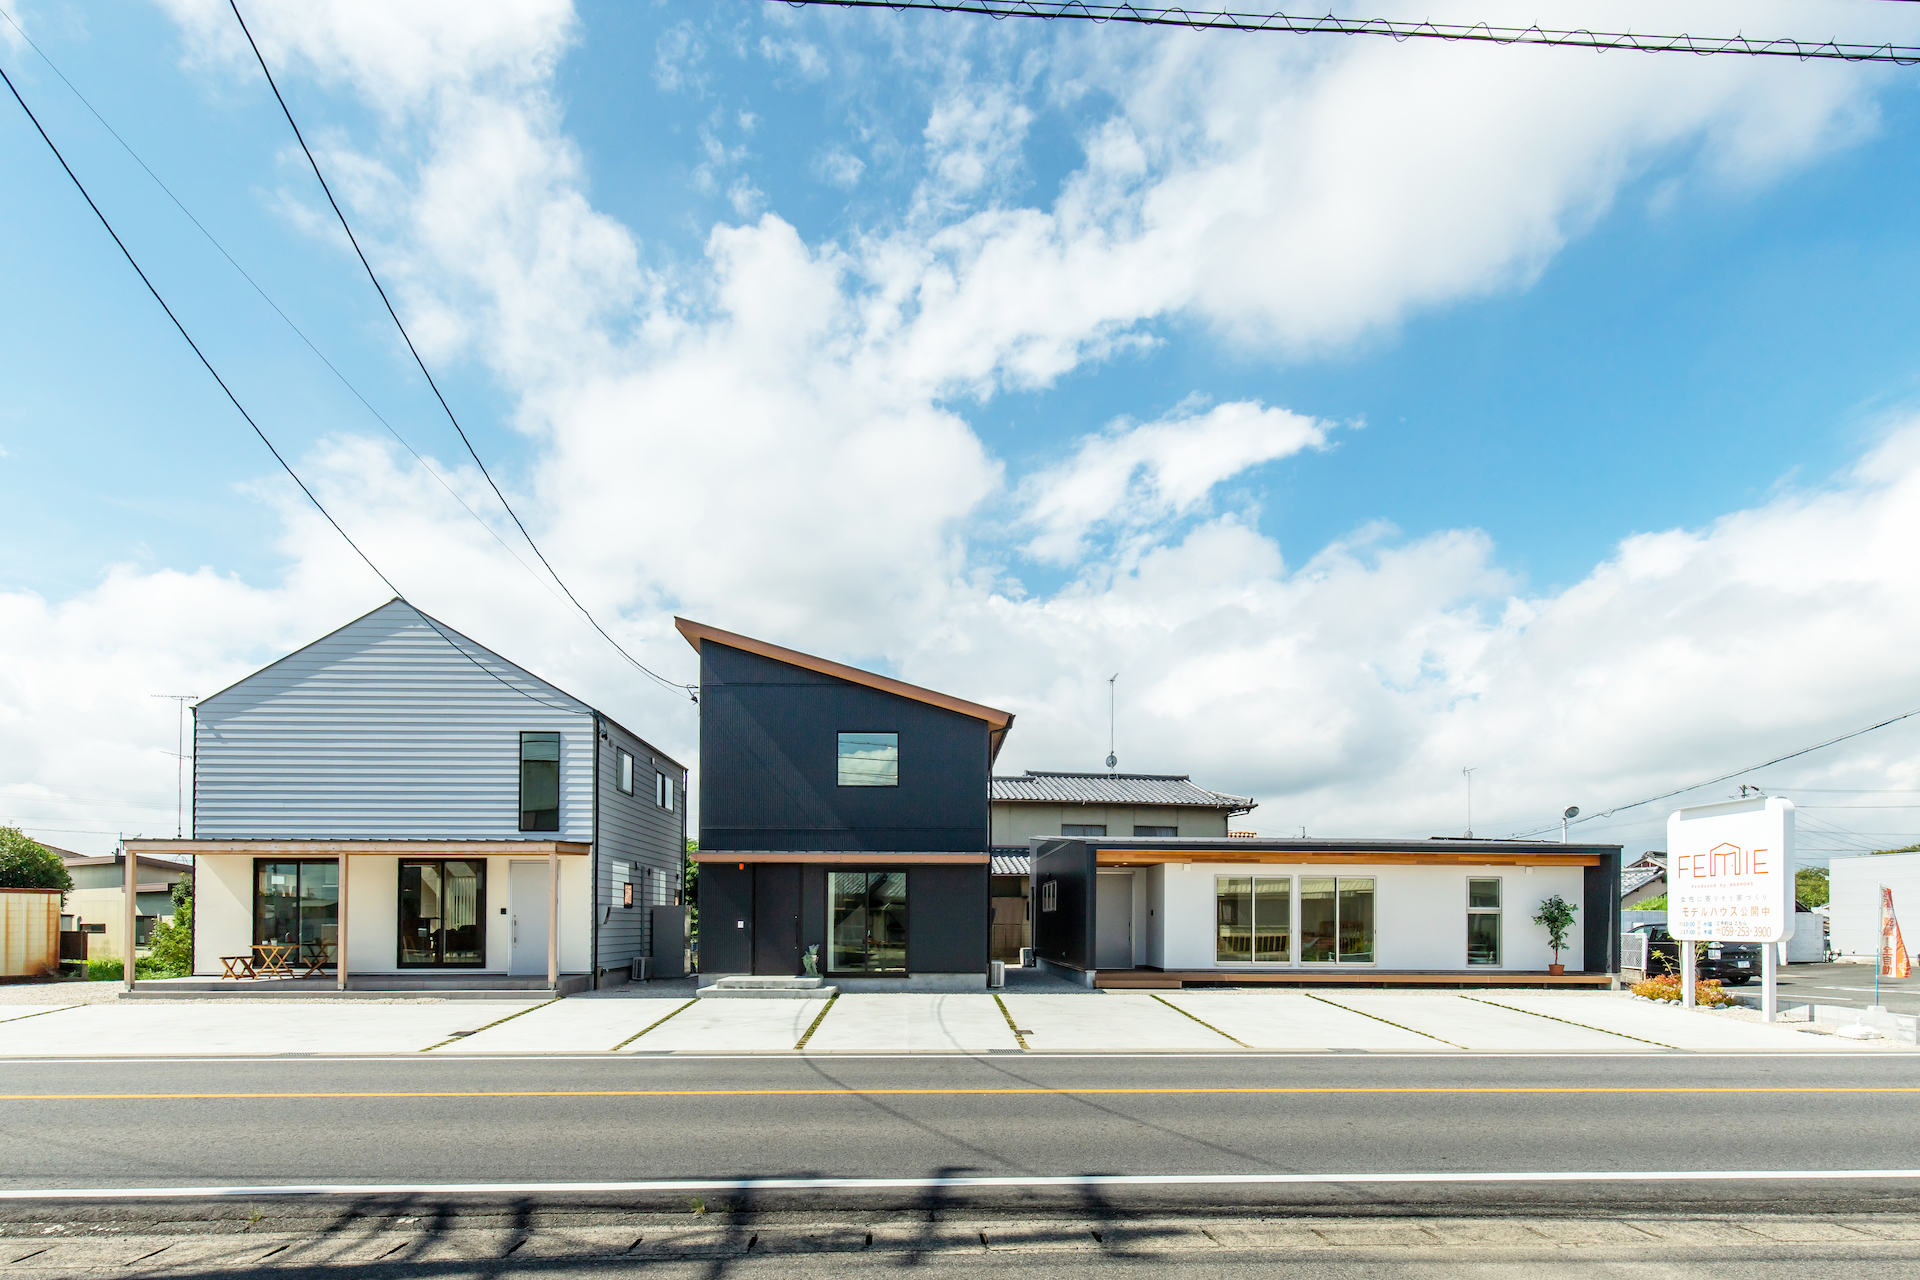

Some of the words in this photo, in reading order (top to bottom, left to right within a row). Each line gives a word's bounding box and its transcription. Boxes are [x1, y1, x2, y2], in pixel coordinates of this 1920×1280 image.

[1680, 894, 1768, 903] 女性に寄りそう家づくり
[1682, 905, 1771, 918] モデルハウス公開中
